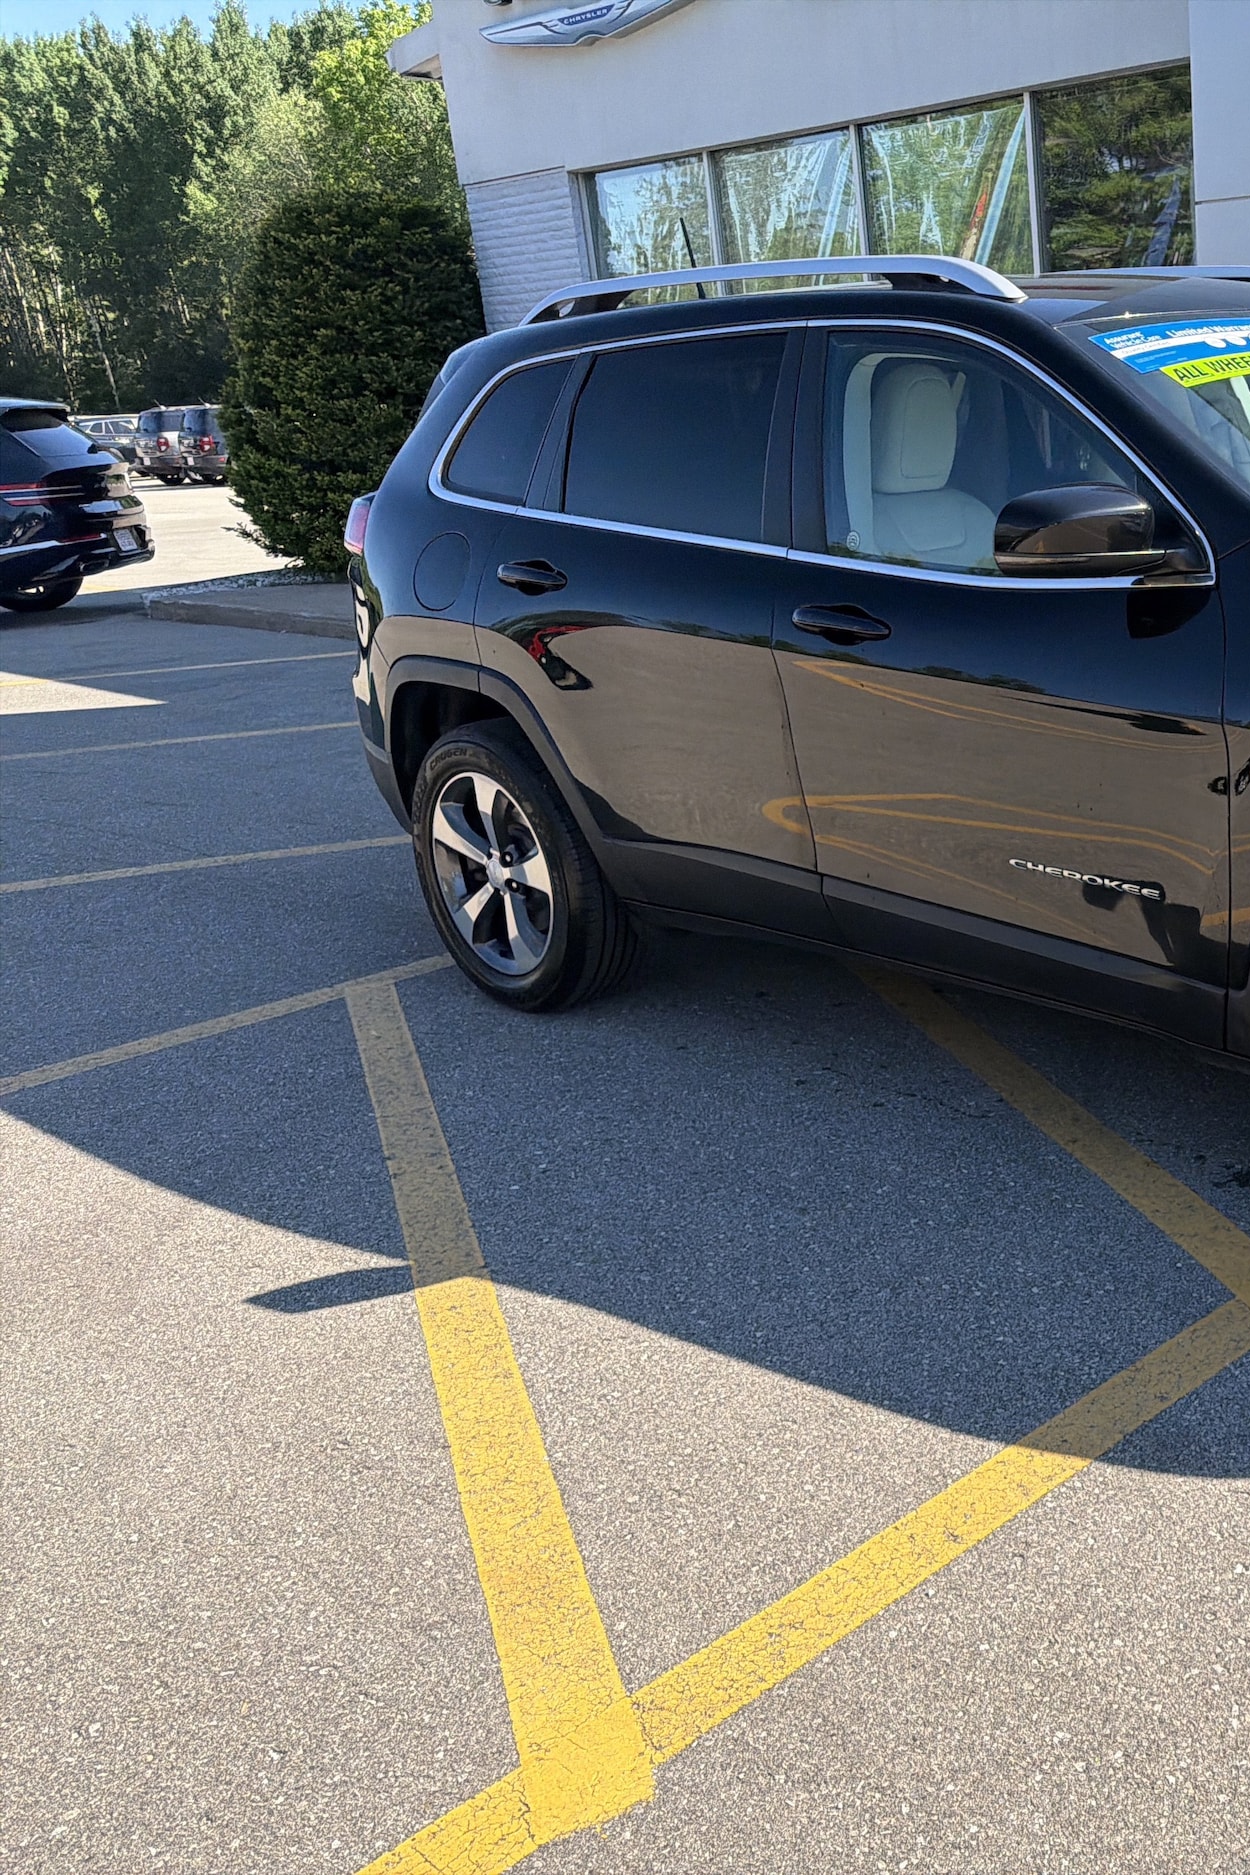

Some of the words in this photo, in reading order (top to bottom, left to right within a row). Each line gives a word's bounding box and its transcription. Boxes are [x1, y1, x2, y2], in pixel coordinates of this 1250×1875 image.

[563, 8, 608, 24] CHRYSLER
[1166, 324, 1213, 337] Limited
[1140, 334, 1162, 344] Care
[1173, 365, 1211, 382] ALL
[1008, 858, 1162, 901] CHEROKEE
